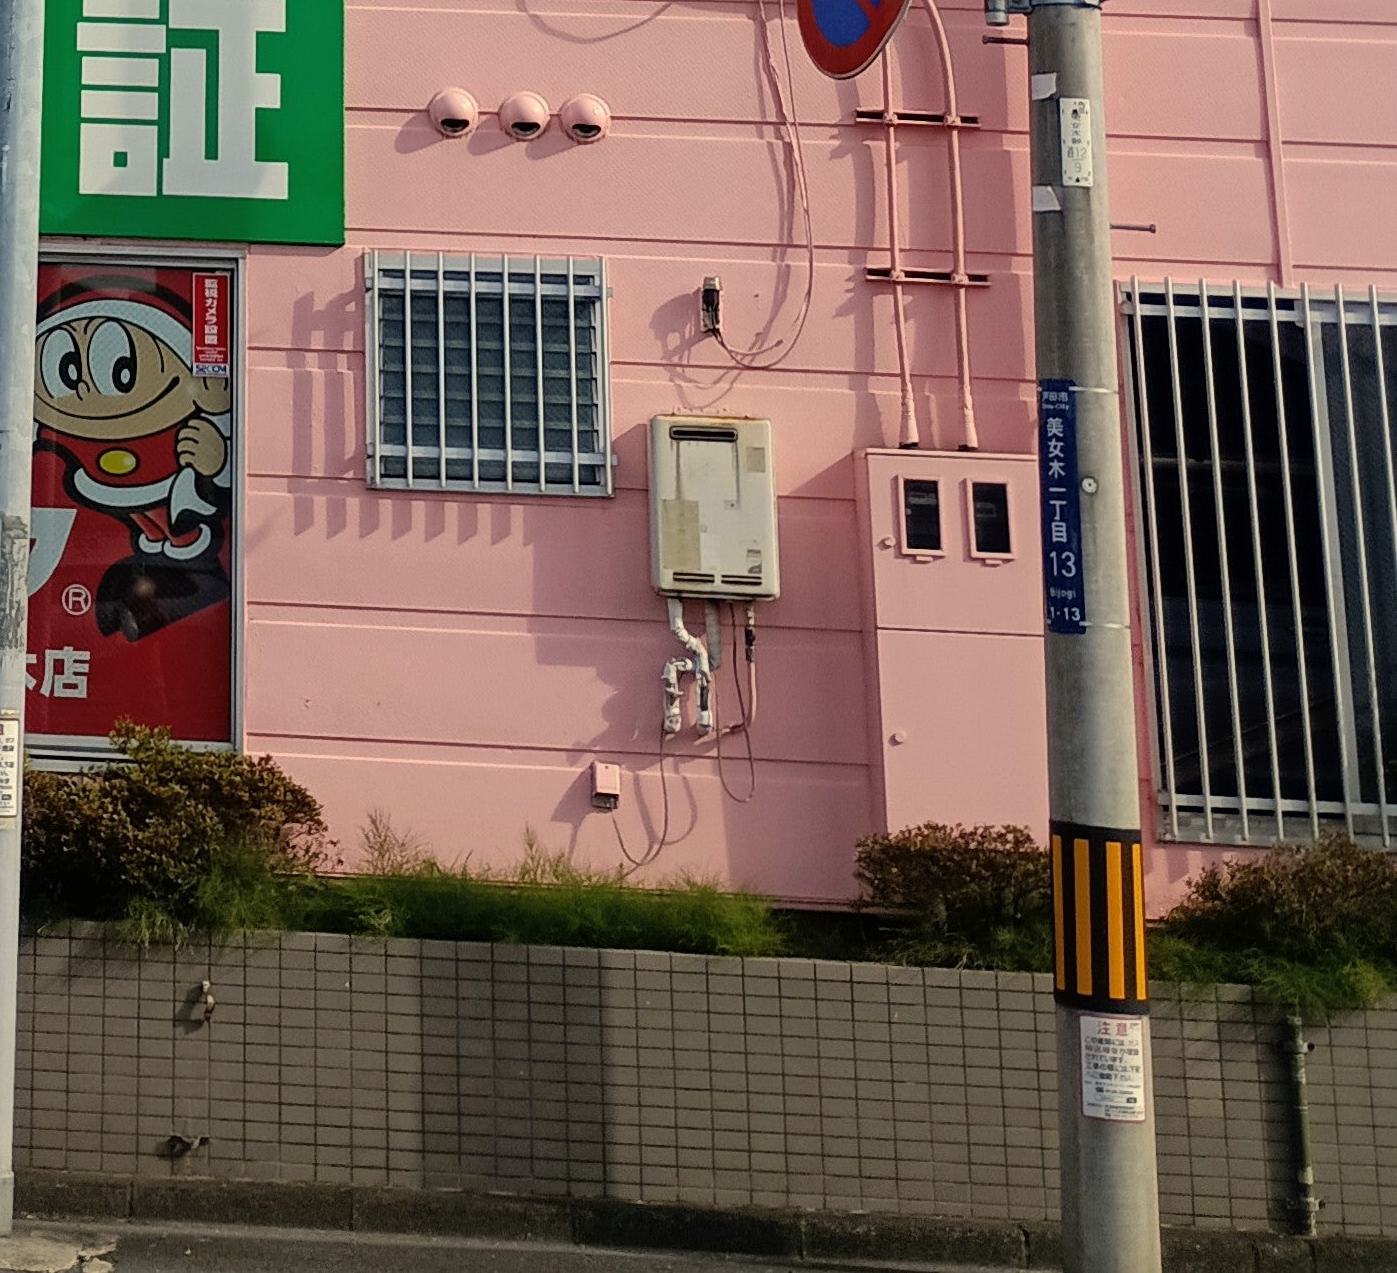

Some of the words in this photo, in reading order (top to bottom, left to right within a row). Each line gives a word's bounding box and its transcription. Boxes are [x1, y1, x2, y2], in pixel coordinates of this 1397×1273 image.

[1046, 417, 1068, 543] 美女木一丁目
[1049, 551, 1076, 578] 13
